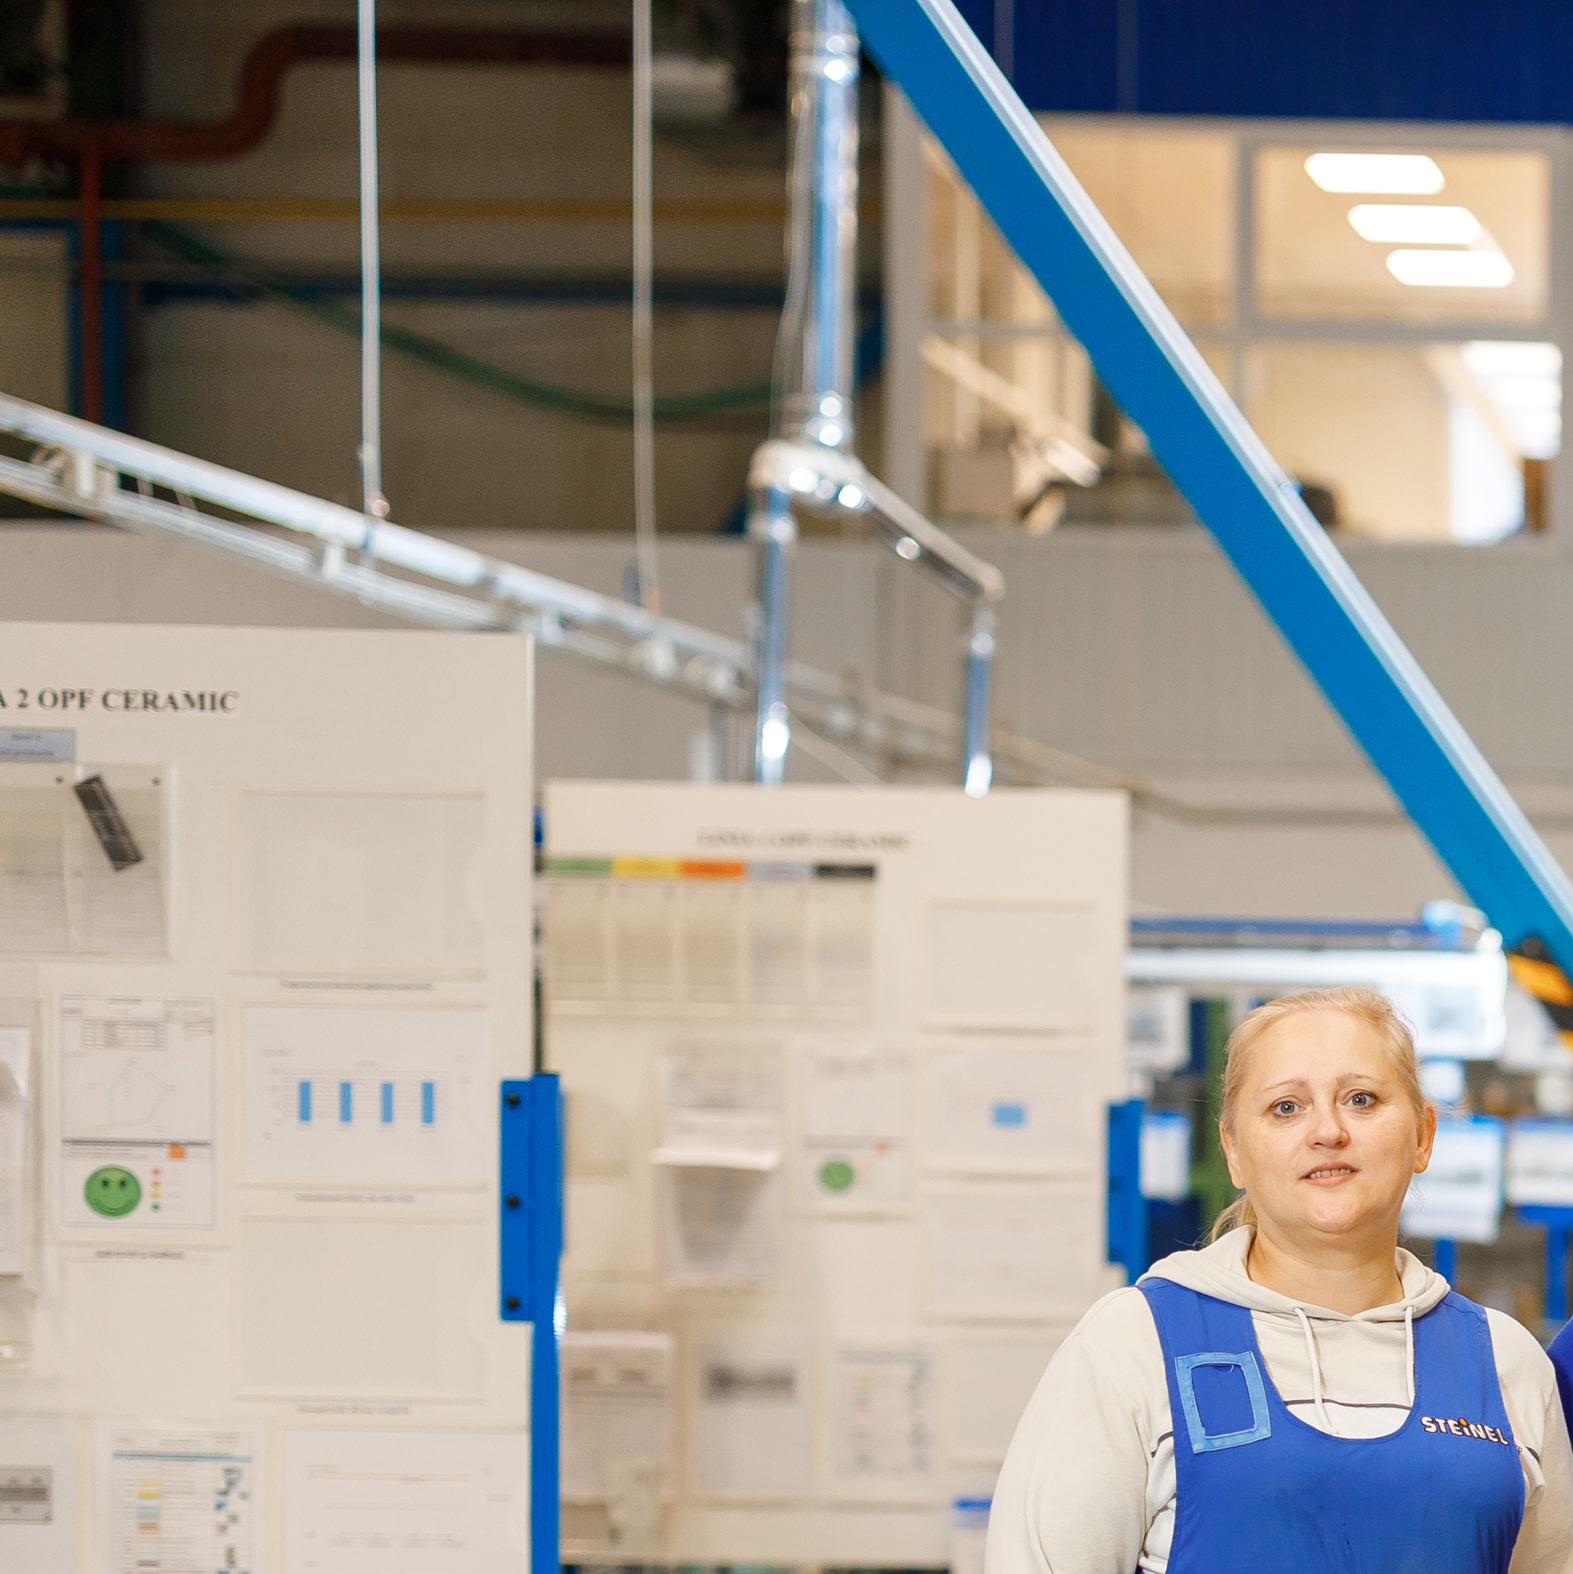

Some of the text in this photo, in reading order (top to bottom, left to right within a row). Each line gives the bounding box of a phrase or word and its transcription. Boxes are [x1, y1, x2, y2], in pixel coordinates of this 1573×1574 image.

[17, 688, 29, 709] 2
[38, 687, 95, 711] OPF
[101, 689, 240, 714] CERAMIC
